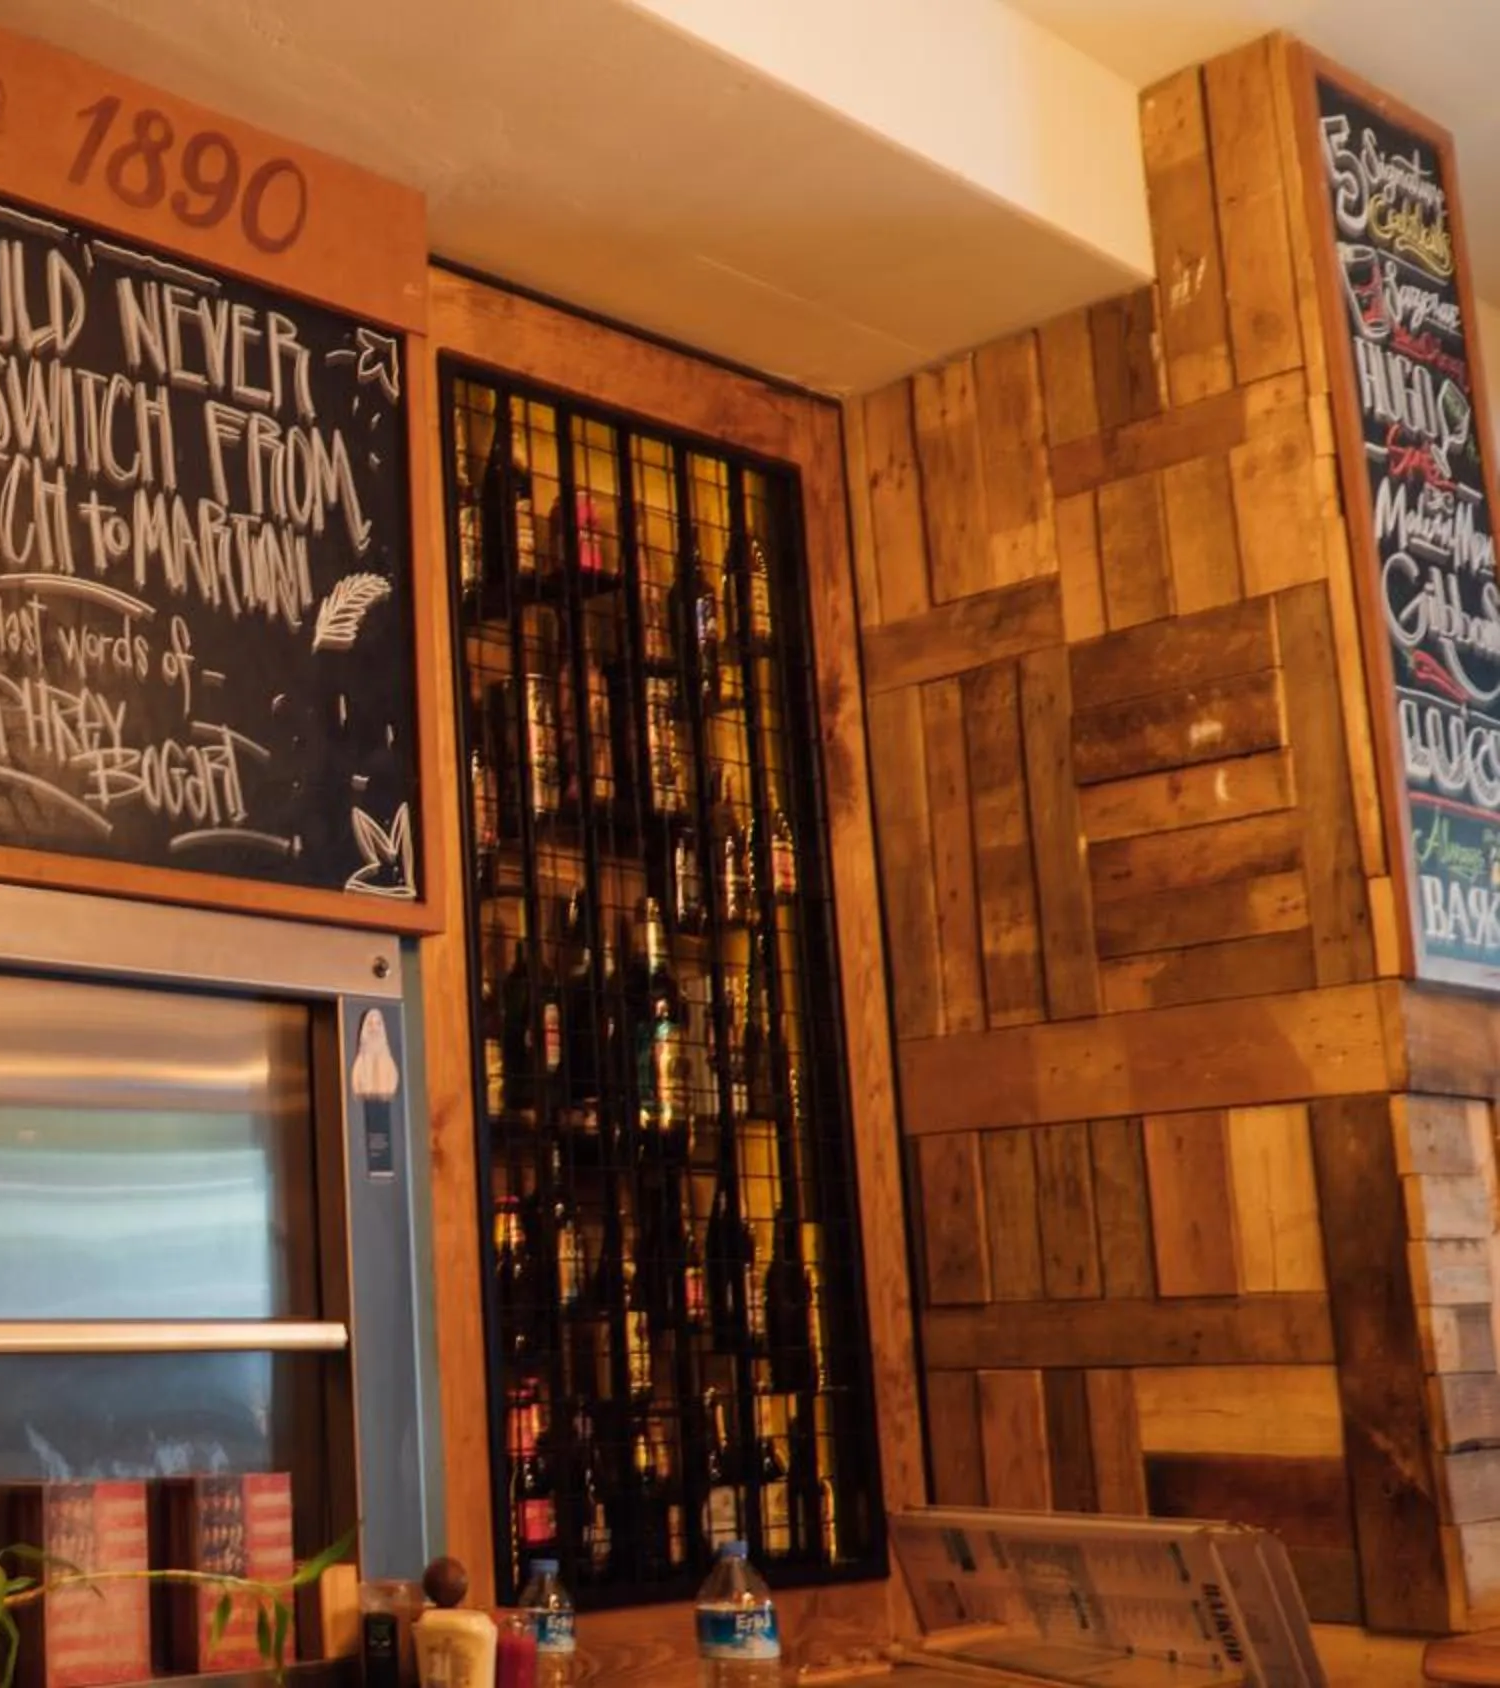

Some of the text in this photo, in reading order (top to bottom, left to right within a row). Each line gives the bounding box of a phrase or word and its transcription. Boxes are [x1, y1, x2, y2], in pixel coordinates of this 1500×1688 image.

[67, 96, 309, 254] 1890
[1320, 114, 1368, 237] 5
[116, 277, 316, 421] NEVER
[1354, 336, 1438, 438] HUGO
[205, 401, 372, 552] FROM
[79, 490, 130, 574] to
[134, 488, 313, 626] MARTINI
[58, 617, 149, 681] words
[162, 615, 195, 717] of
